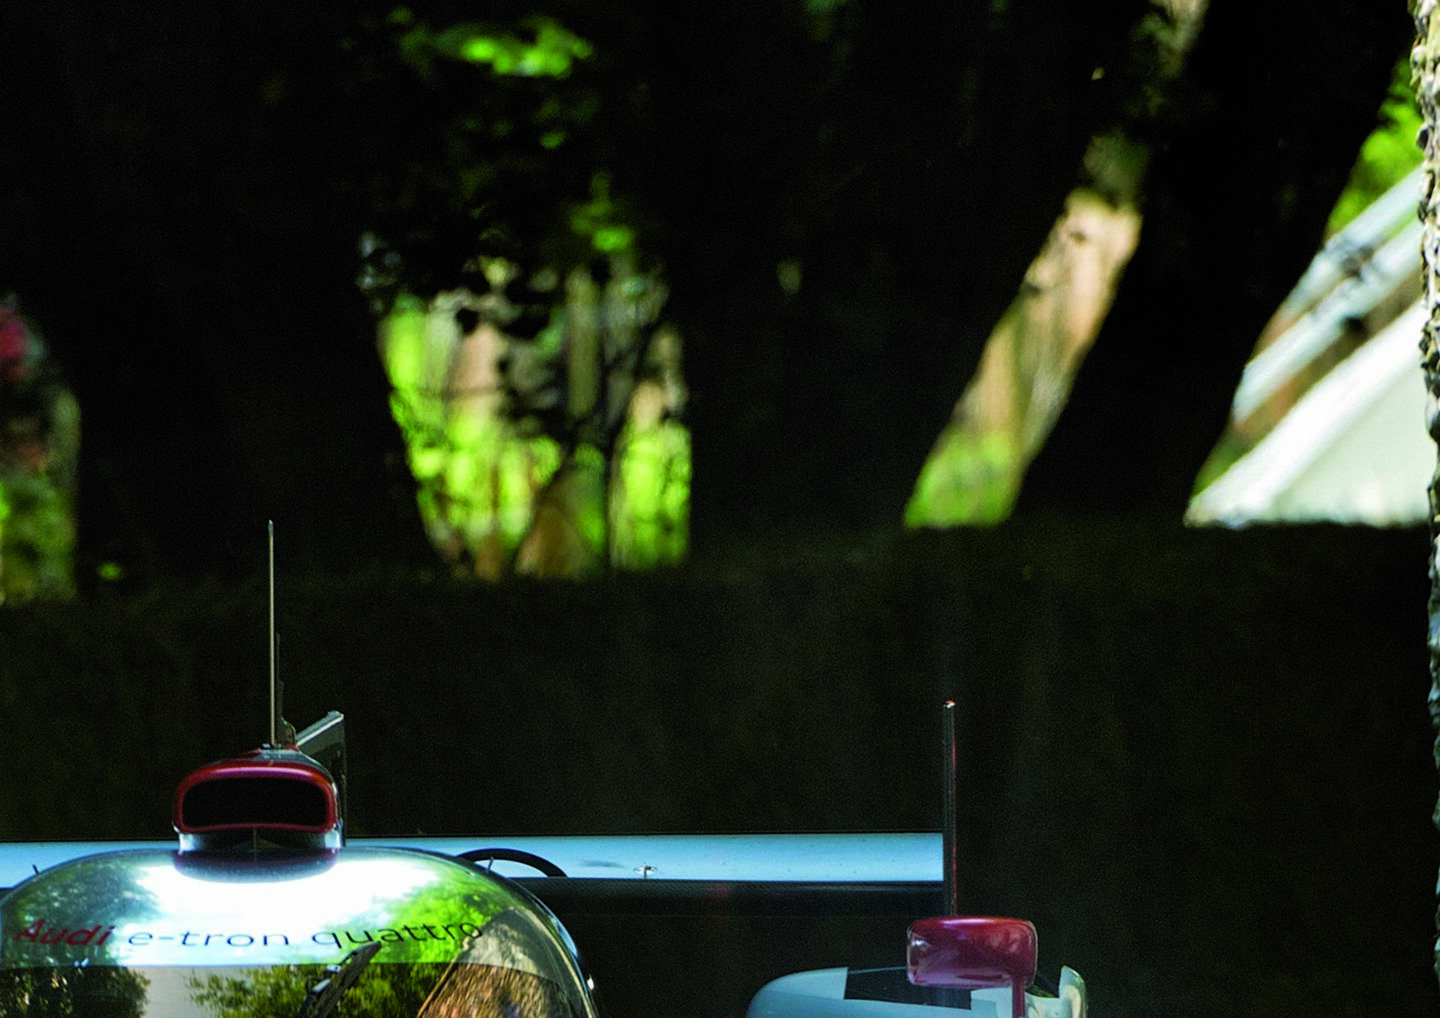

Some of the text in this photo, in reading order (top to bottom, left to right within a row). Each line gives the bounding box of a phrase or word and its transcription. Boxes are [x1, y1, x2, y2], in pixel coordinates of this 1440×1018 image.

[12, 918, 483, 949] Audi e-tron quattro
